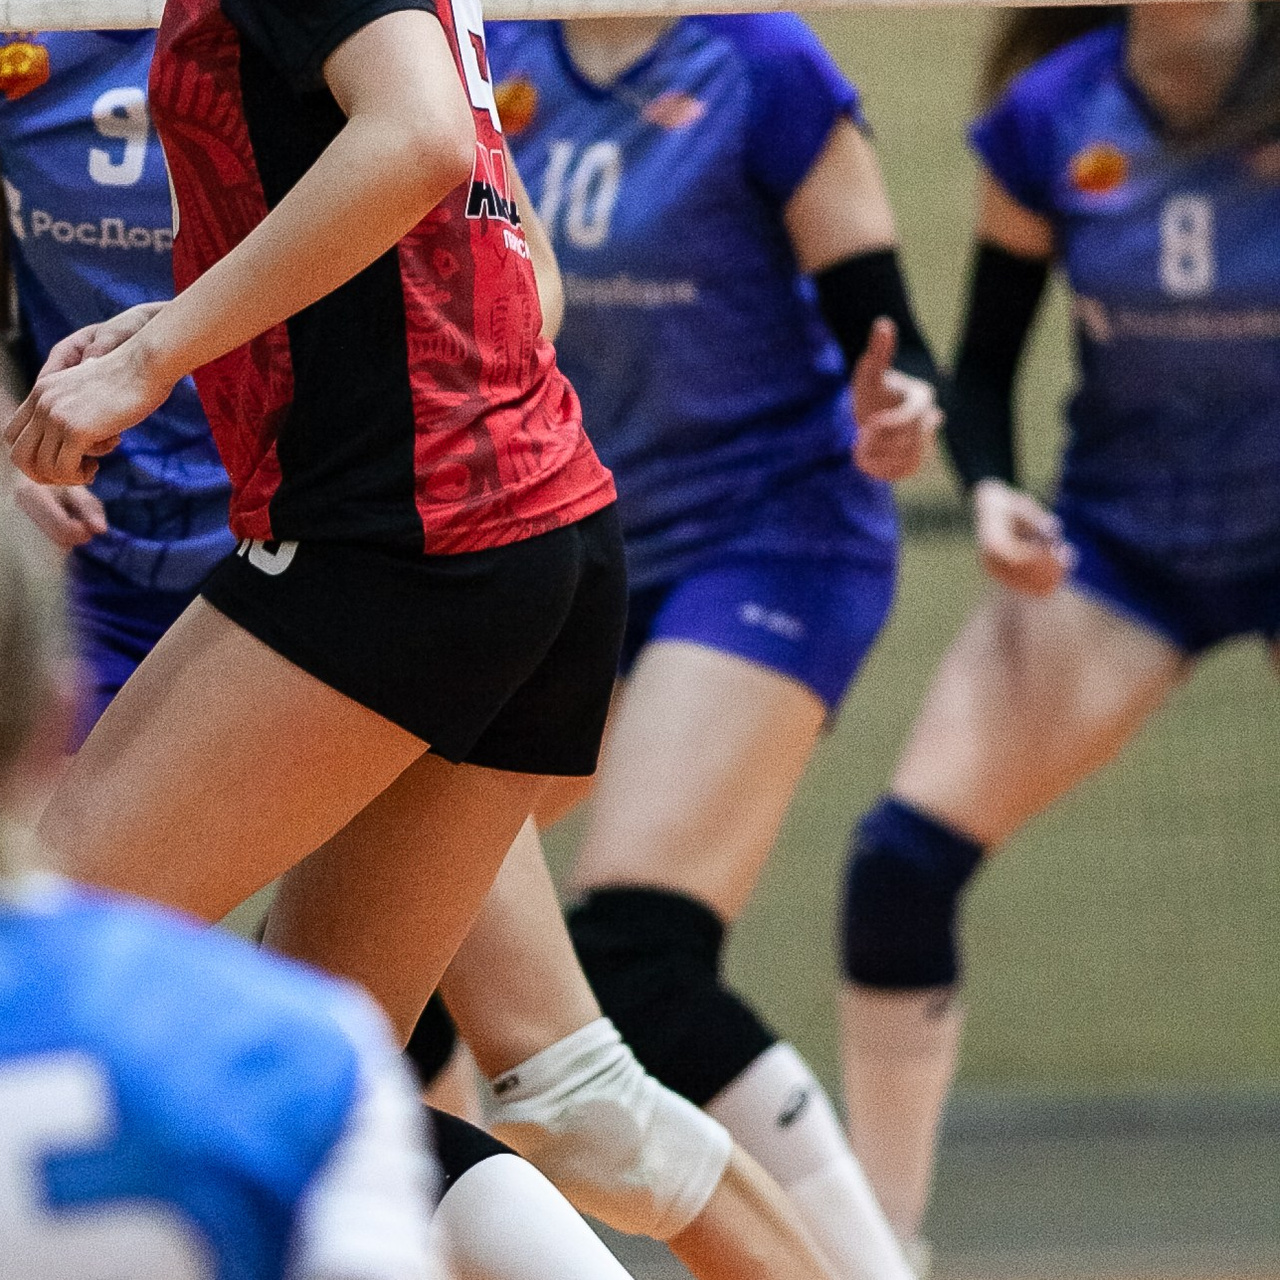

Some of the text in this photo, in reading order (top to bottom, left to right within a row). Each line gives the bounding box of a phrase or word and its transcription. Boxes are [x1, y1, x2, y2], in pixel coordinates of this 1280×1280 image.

[89, 86, 149, 188] 9
[538, 140, 622, 248] 10
[1160, 193, 1217, 297] 8
